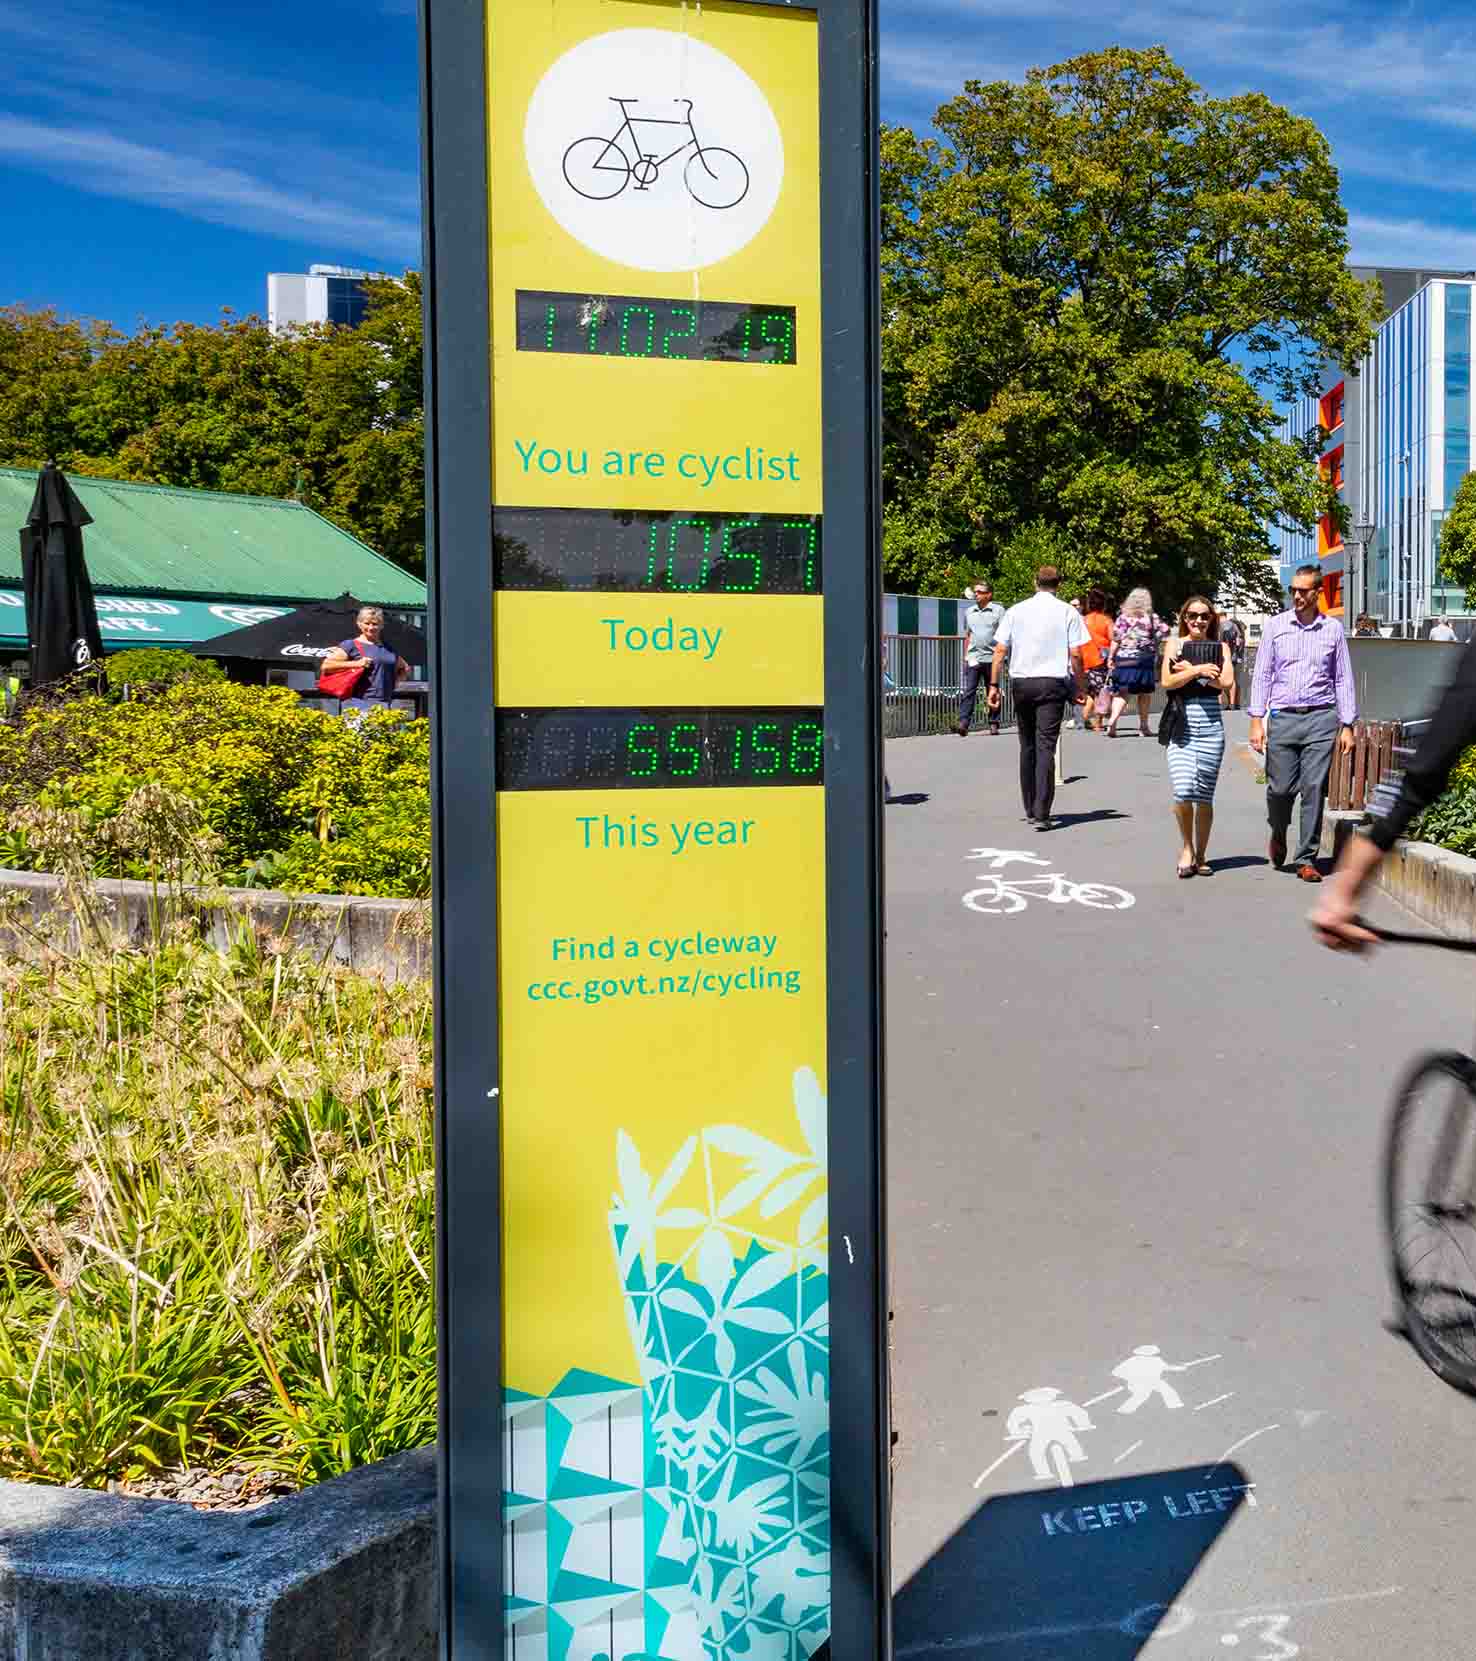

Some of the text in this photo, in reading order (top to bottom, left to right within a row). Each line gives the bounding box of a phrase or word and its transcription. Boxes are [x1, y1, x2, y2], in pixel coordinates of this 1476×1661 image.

[514, 439, 800, 487] You are cyclist
[646, 519, 817, 591] 1057
[600, 616, 723, 660] Today
[627, 722, 823, 776] 55158
[575, 814, 755, 855] This year
[552, 931, 777, 961] Find a cycleway
[527, 965, 801, 1004] ccc.govt.nz/cycling
[1041, 1483, 1257, 1536] KEEP LEFT
